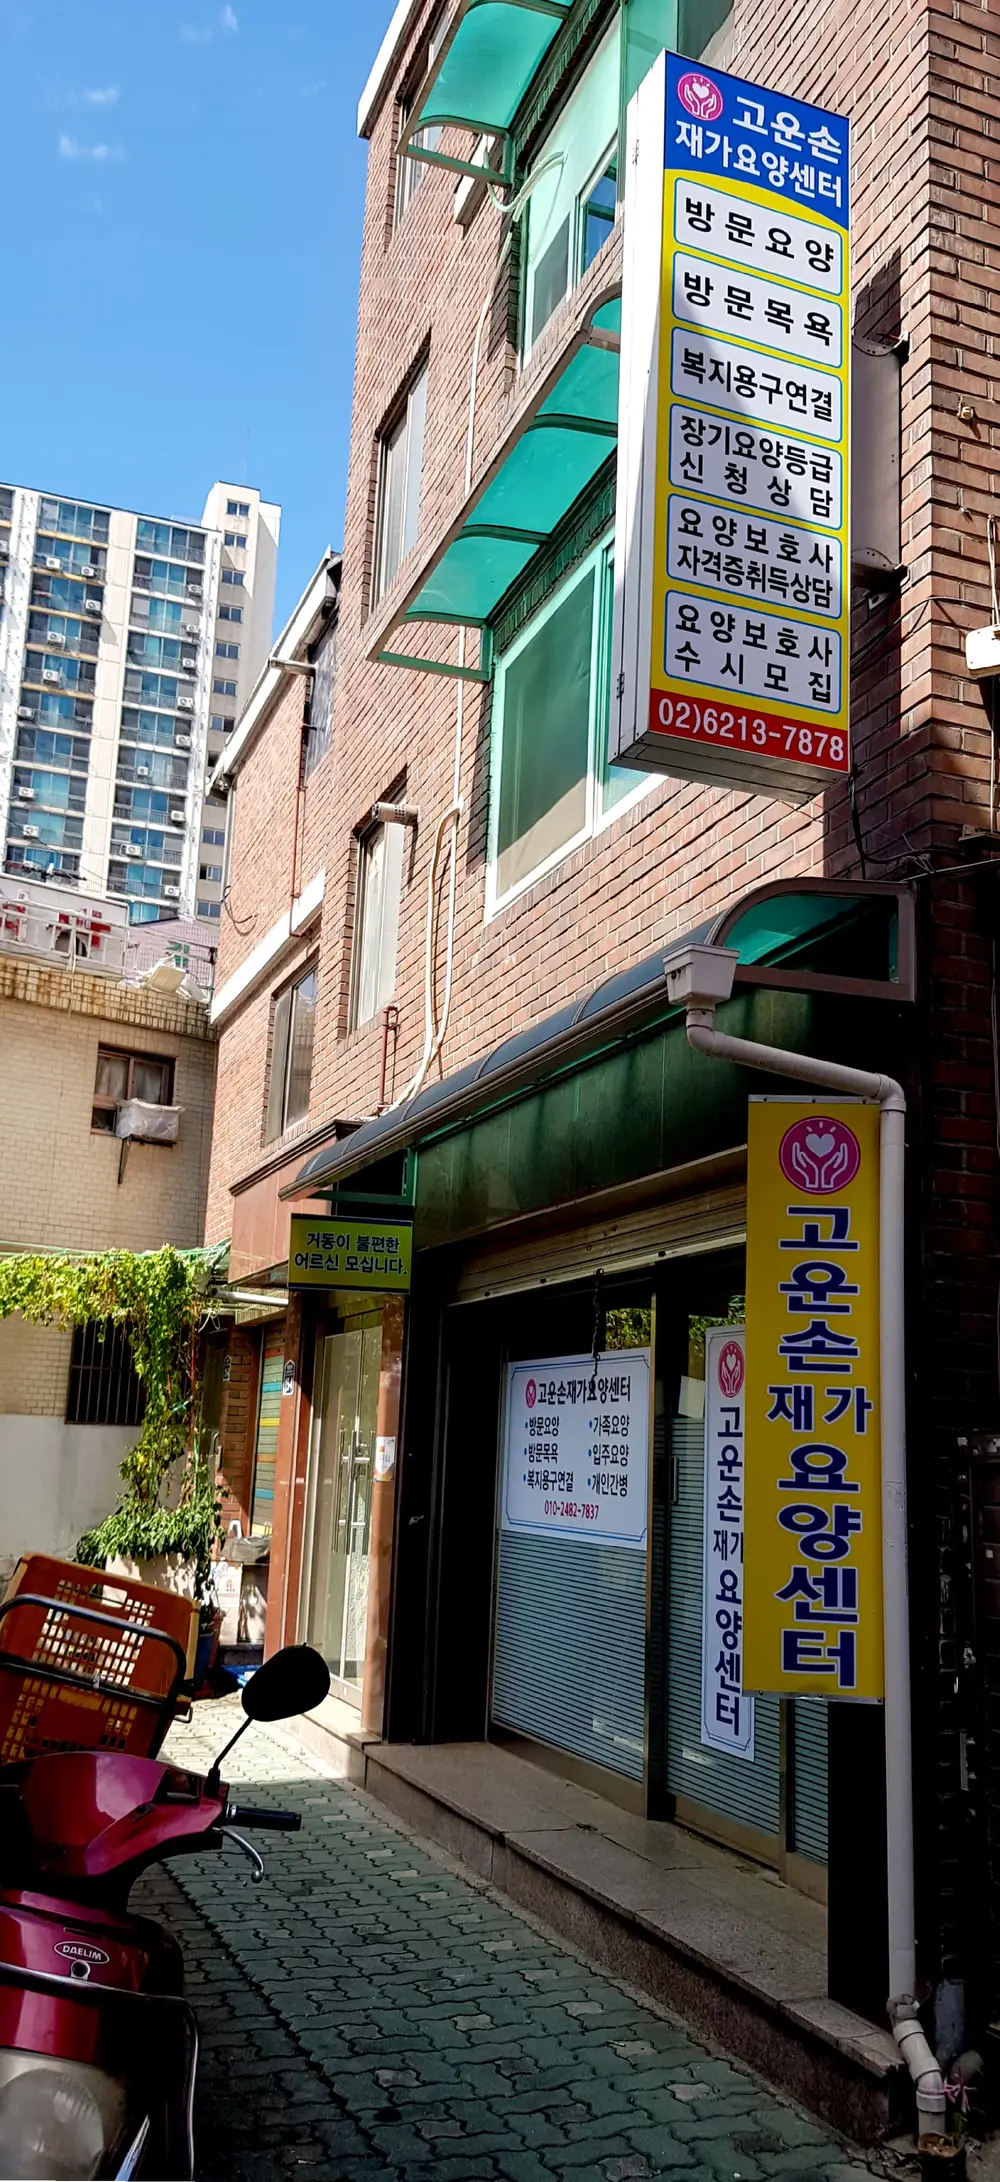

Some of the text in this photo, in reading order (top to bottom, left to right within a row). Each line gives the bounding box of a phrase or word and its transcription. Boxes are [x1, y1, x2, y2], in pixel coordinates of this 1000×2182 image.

[733, 96, 842, 164] 고운손
[676, 119, 842, 207] 재가요양센터
[681, 347, 833, 420] 복지용구연결
[680, 414, 833, 483] 장기요양등급
[677, 507, 833, 574] 요양보호사
[677, 543, 833, 609] 자격증취득상담
[675, 603, 833, 668] 요양보호사
[658, 697, 844, 761] 02)6213-7878
[306, 1232, 400, 1254] 거동이 불편한
[294, 1252, 408, 1275] 어르신 모십니다.
[529, 1416, 560, 1436] 방문요양
[593, 1414, 630, 1437] 가족요양
[528, 1442, 559, 1463] 방문목욕
[592, 1443, 629, 1467] 입주요양
[527, 1469, 574, 1492] 복지용구연결
[591, 1473, 628, 1497] 개인간병
[544, 1500, 599, 1520] 010-2482-7837
[62, 1945, 102, 1960] DAELIM
